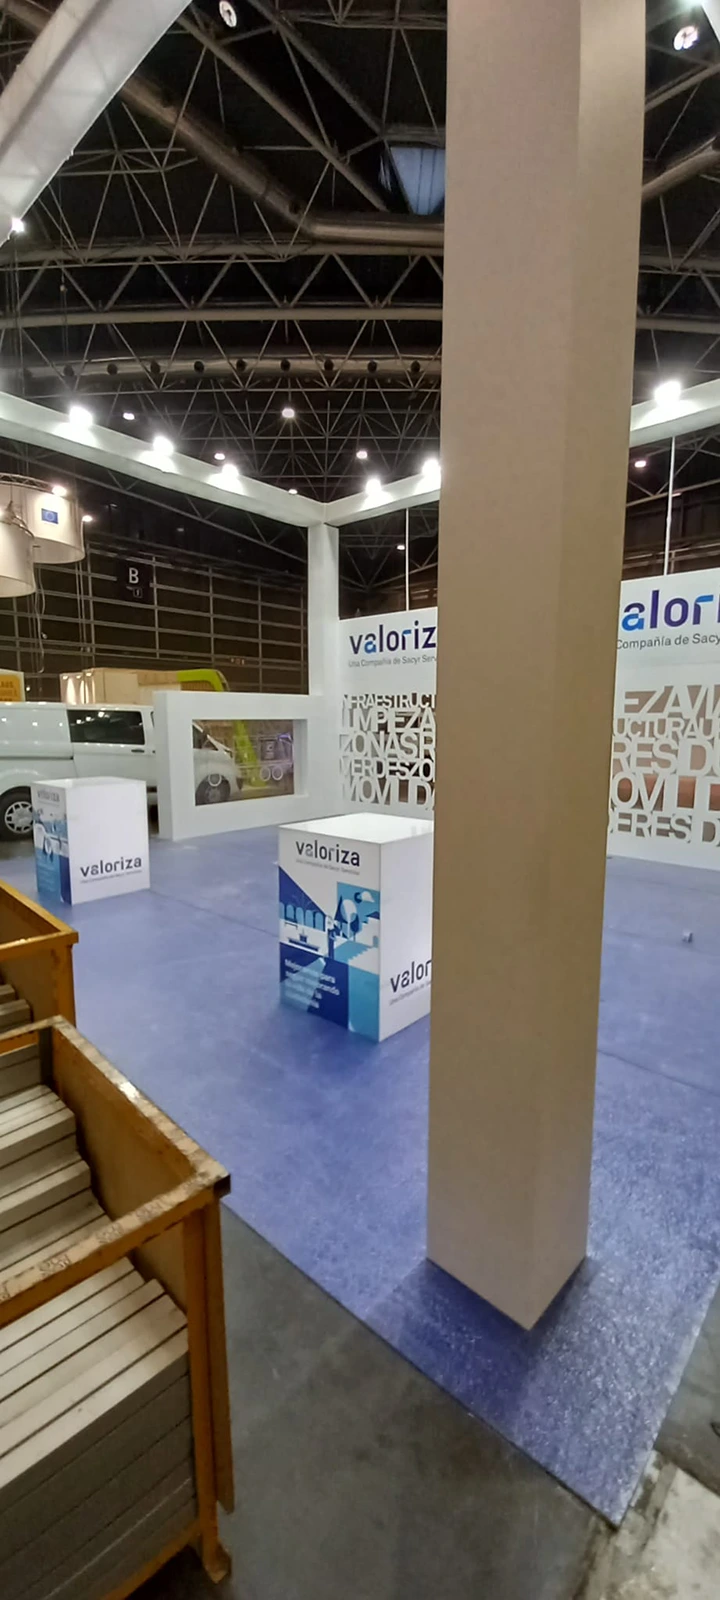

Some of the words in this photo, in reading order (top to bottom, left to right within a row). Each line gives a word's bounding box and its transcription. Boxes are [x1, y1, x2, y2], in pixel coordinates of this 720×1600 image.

[129, 567, 139, 584] B
[621, 588, 720, 631] alor
[349, 620, 436, 655] valoriz
[674, 634, 689, 646] de
[692, 633, 720, 646] Sacy
[80, 857, 142, 877] valoriza
[296, 839, 360, 867] valoriza
[390, 960, 432, 993] valor
